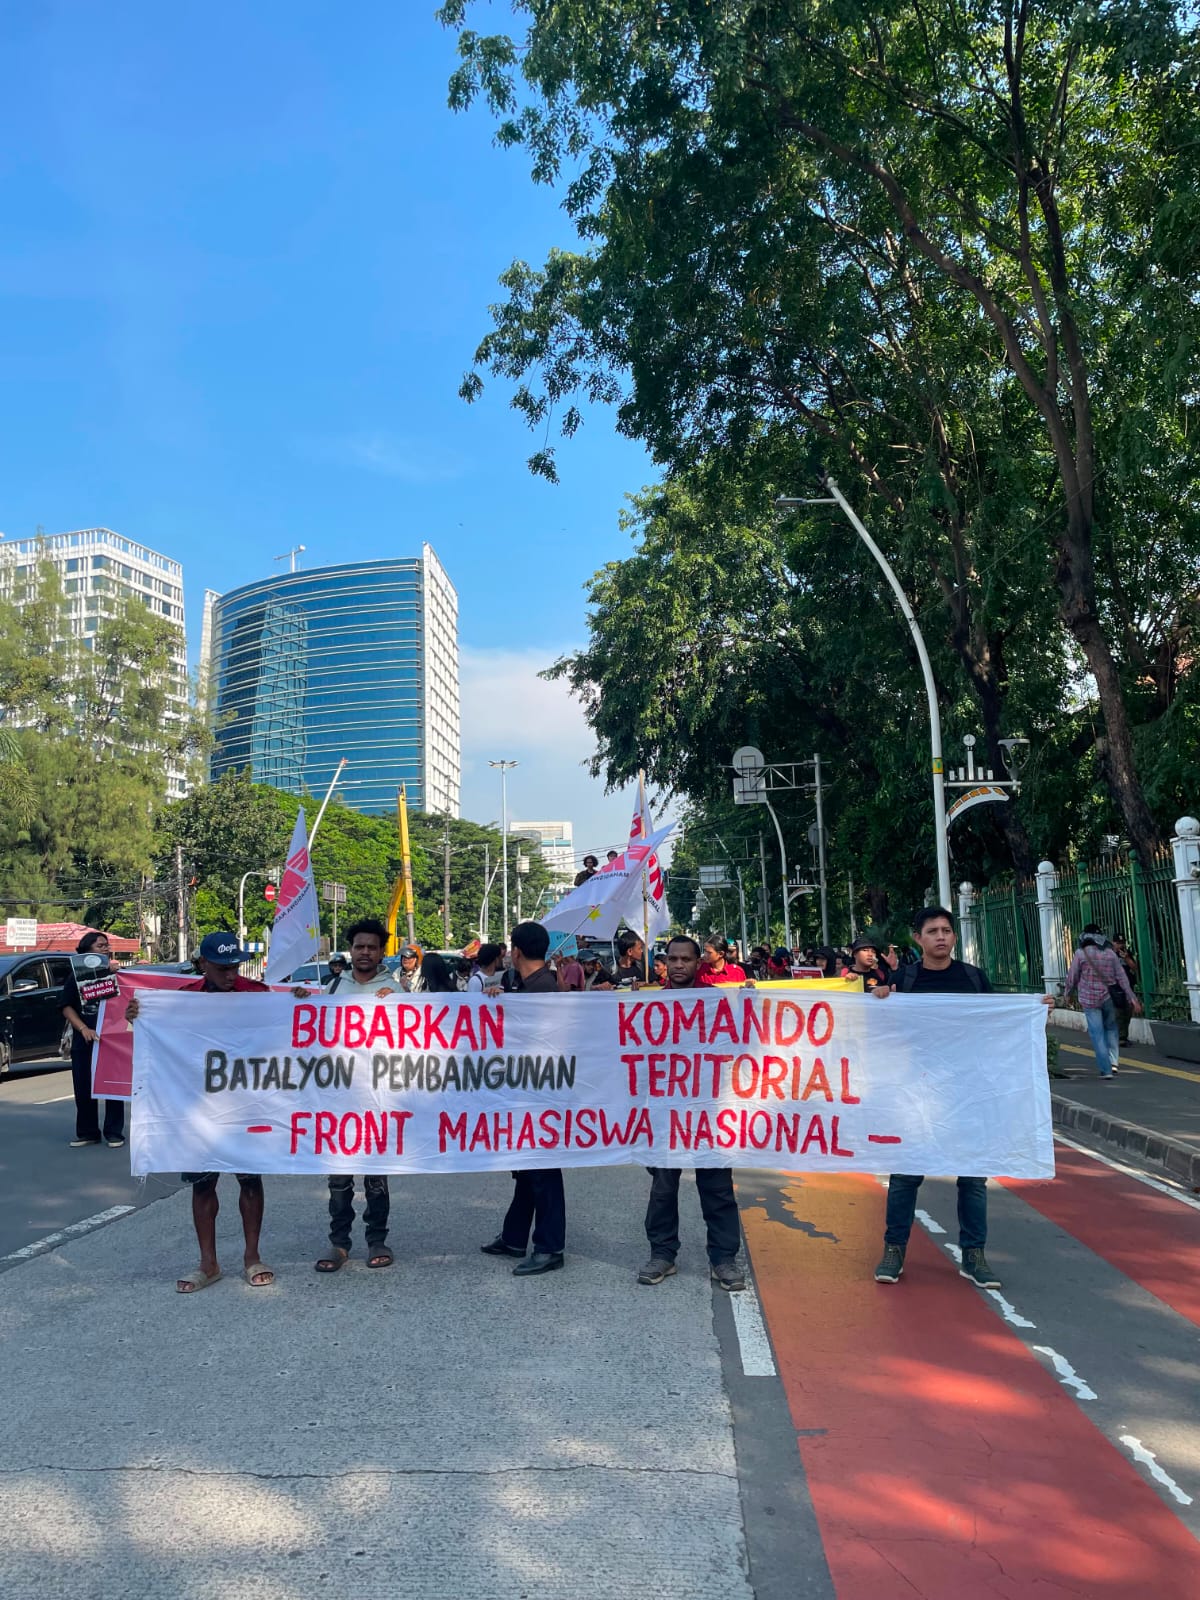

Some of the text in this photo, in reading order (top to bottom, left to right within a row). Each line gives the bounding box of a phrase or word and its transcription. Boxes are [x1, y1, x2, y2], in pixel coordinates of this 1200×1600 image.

[292, 1004, 504, 1048] BUBARKAN
[619, 997, 834, 1047] KOMANDO
[206, 1051, 576, 1093] BATALYON PEMBANGUNAN
[621, 1054, 860, 1104] TERITORIAL
[291, 1111, 413, 1155] FRONT
[439, 1109, 652, 1153] MAHASISWA
[670, 1109, 853, 1157] NASIONAL
